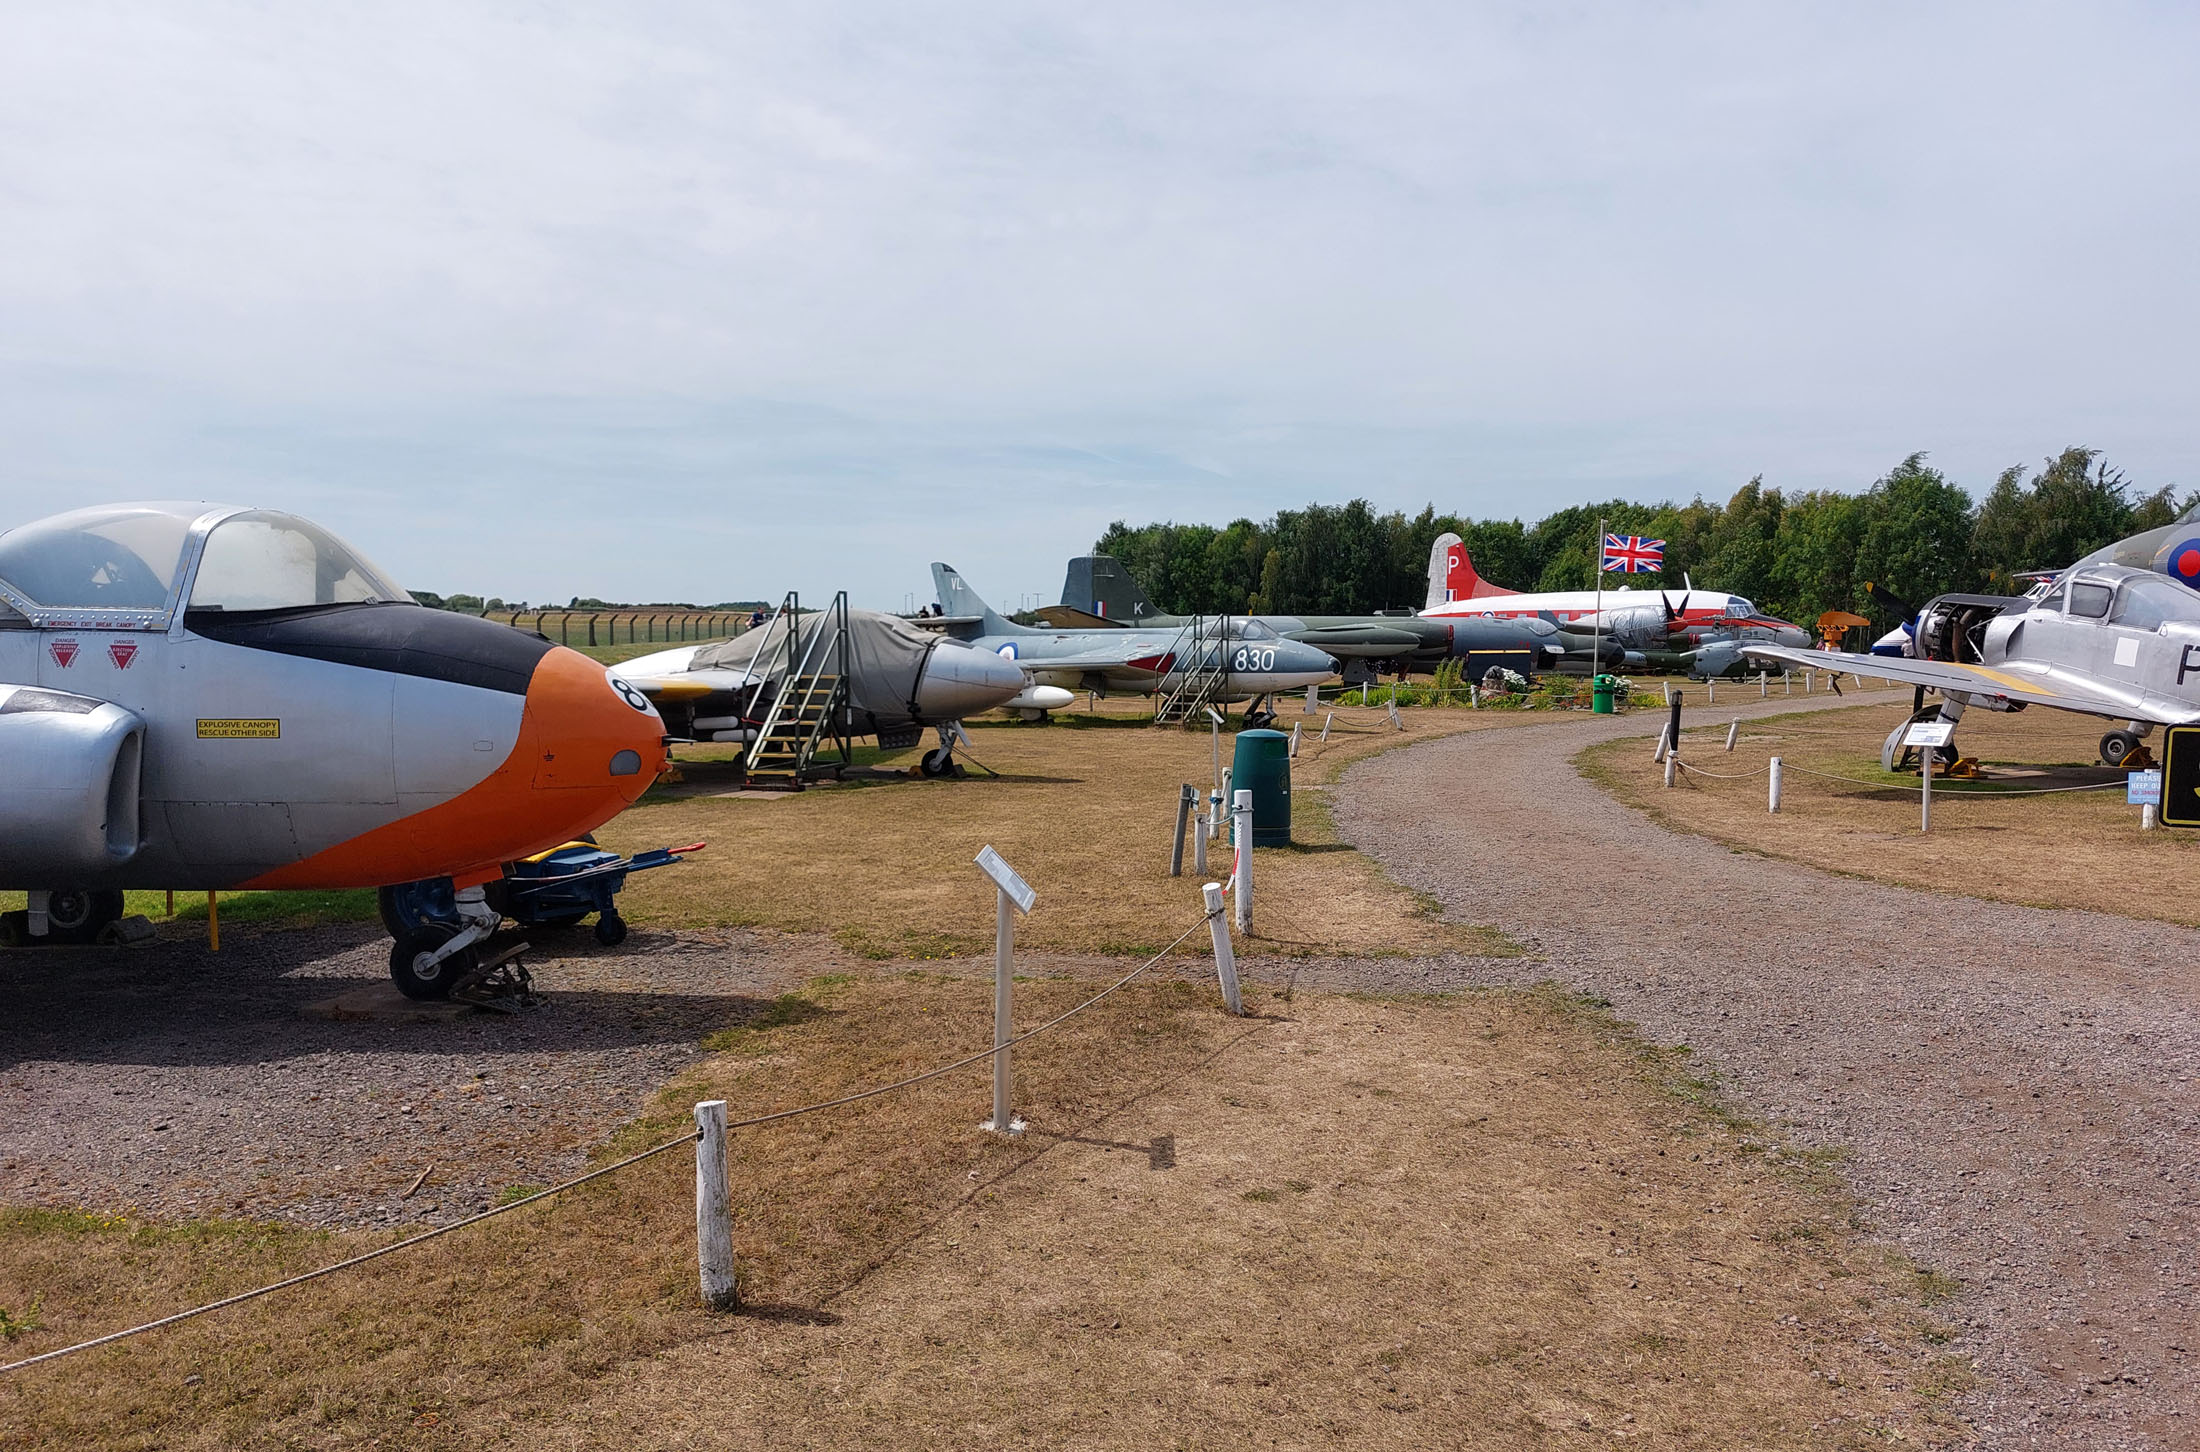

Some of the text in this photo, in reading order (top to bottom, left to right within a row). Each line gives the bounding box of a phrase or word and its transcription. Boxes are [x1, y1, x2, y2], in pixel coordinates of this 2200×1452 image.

[1448, 555, 1460, 575] P
[951, 577, 965, 590] VL
[1133, 602, 1144, 615] K
[1235, 649, 1275, 671] 830
[612, 679, 648, 711] 8
